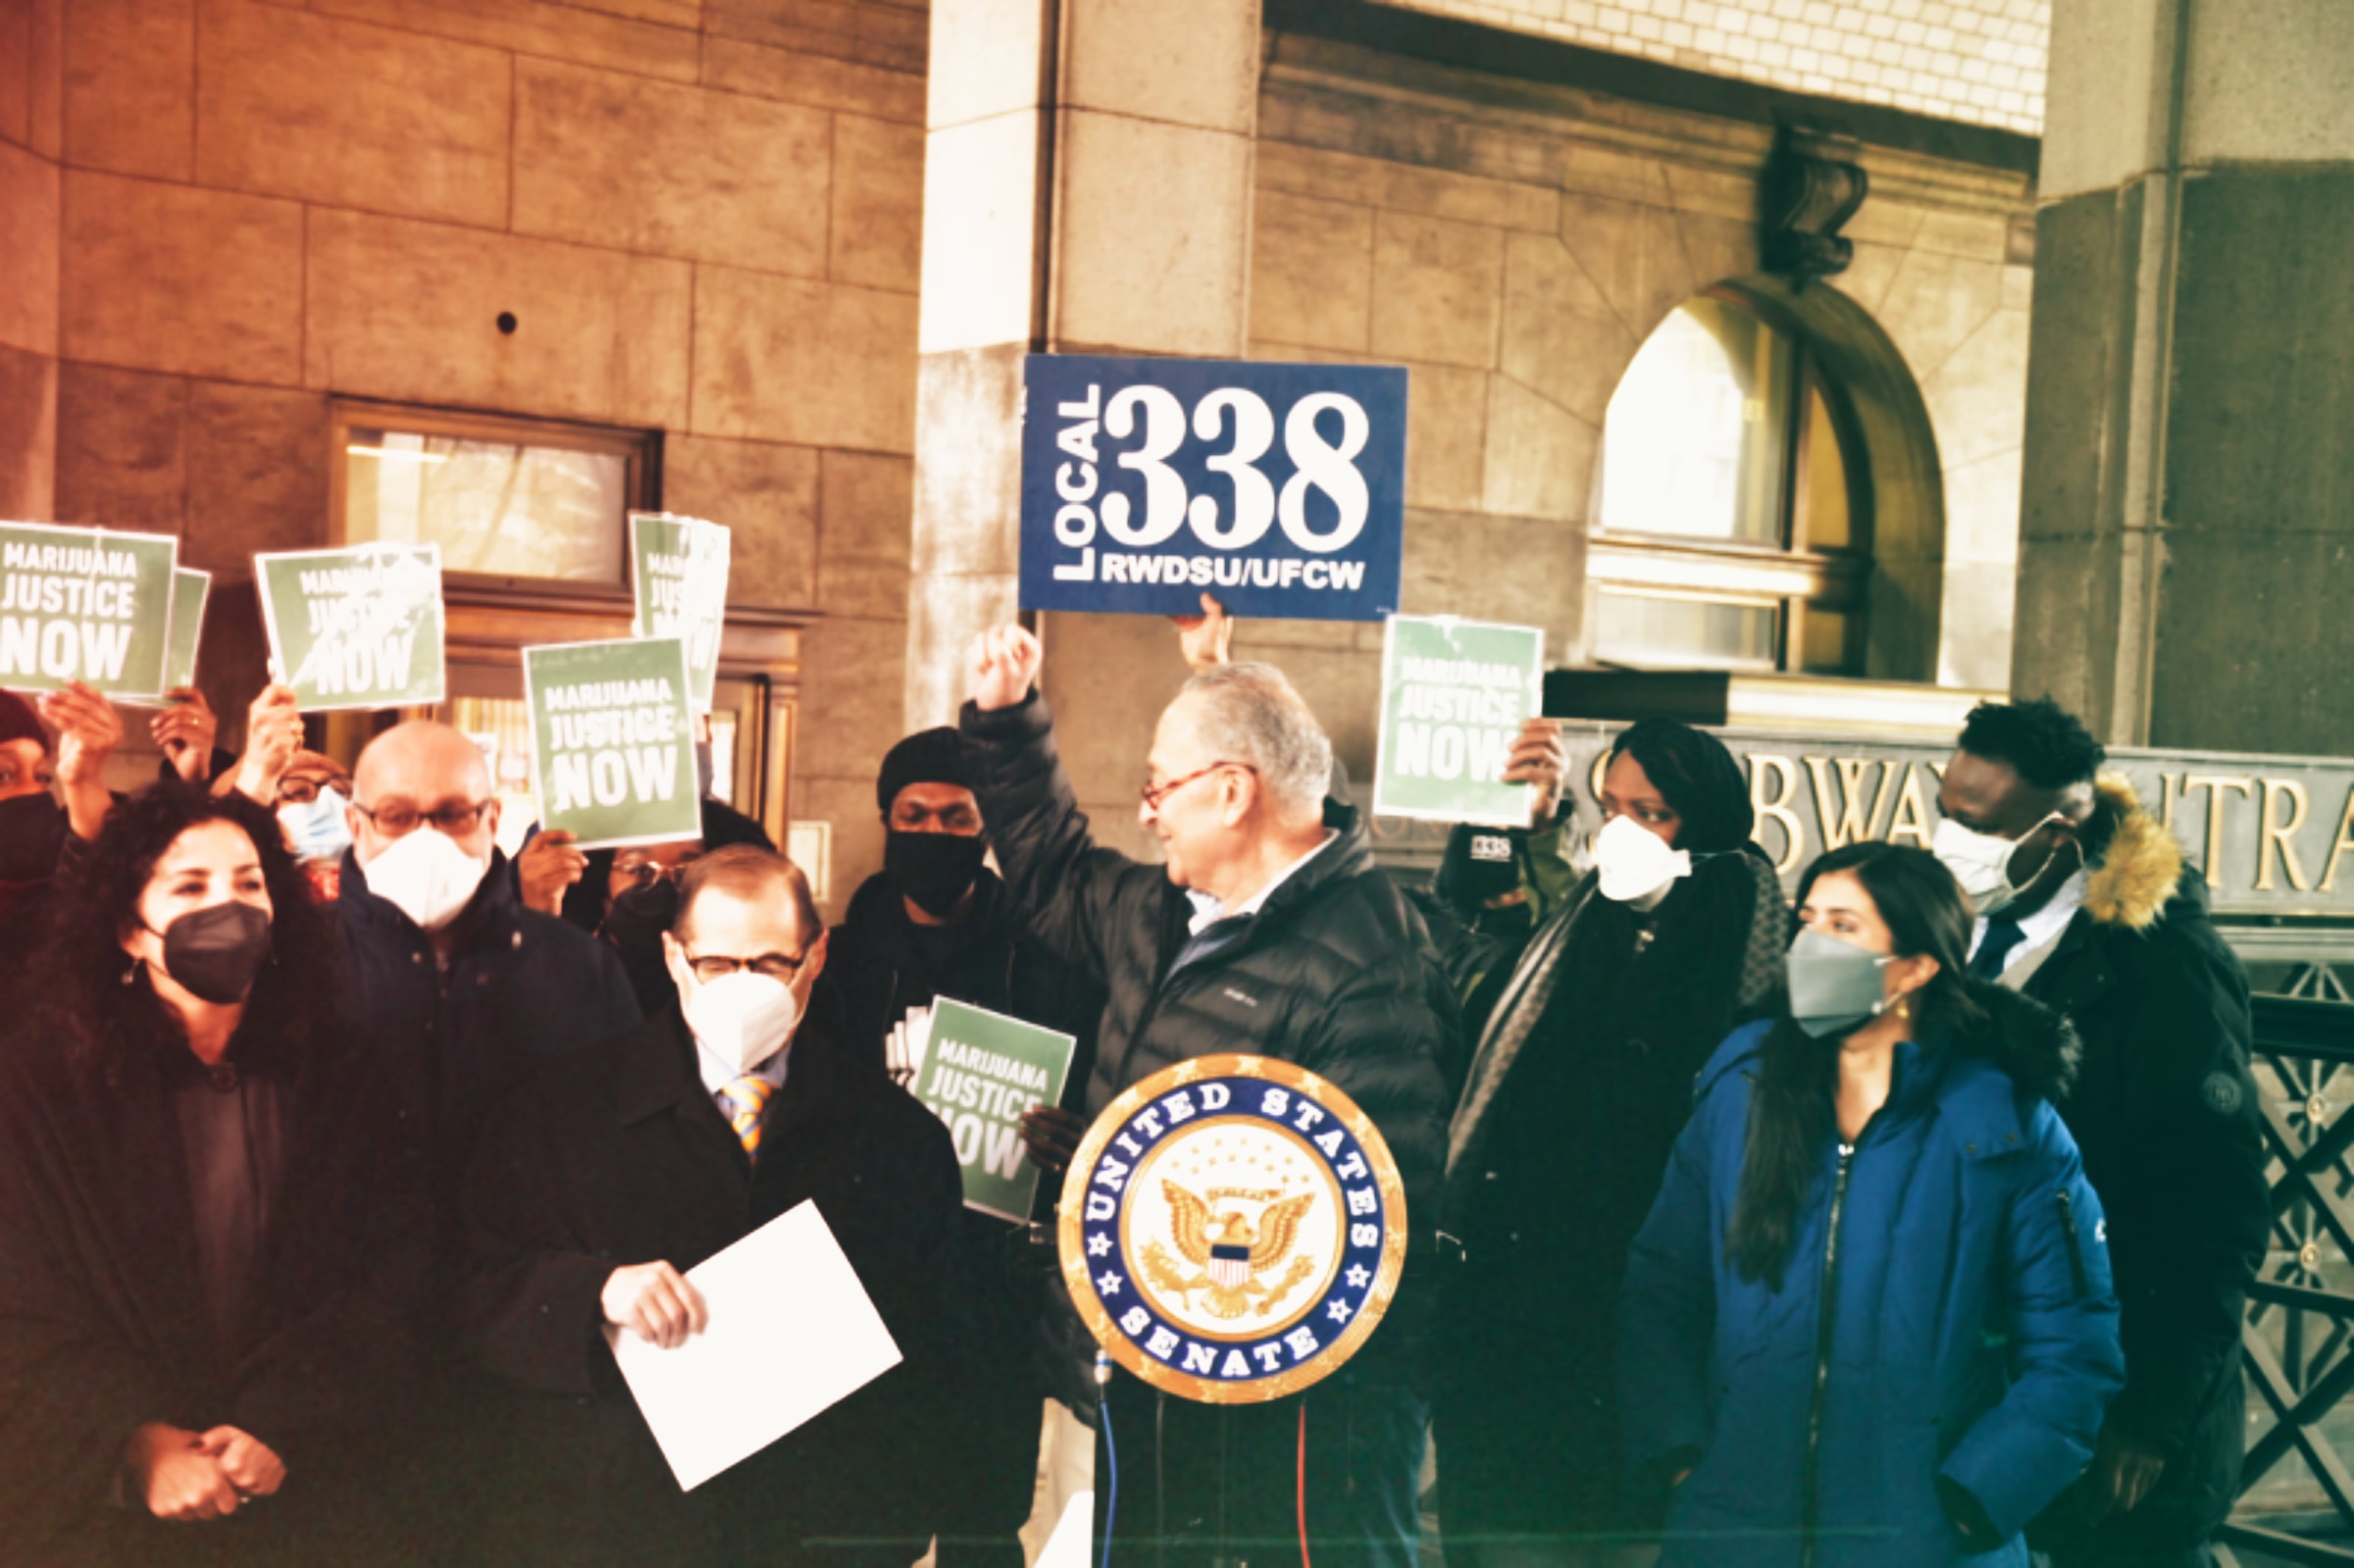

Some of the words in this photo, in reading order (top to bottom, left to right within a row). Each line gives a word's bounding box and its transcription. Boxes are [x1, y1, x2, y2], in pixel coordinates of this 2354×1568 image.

[1052, 382, 1101, 582] LOCAL
[1100, 383, 1370, 553] 338
[3, 541, 137, 578] MARIJUANA
[1100, 553, 1366, 590] RWDSU/UFCW
[1, 573, 135, 620] JUSTICE
[0, 616, 133, 681] NOW
[315, 632, 416, 695] NOW
[544, 677, 674, 712] MARIJUANA
[1398, 684, 1519, 726] JUSTICE
[549, 705, 677, 751] JUSTICE
[1395, 722, 1518, 784] NOW
[552, 745, 678, 813] NOW
[937, 1037, 1049, 1091] MARIJUANA
[927, 1066, 1043, 1122] JUSTICE
[1086, 1082, 1230, 1222] UNITED
[1260, 1088, 1378, 1248] STATES
[1119, 1305, 1319, 1377] SENATE
